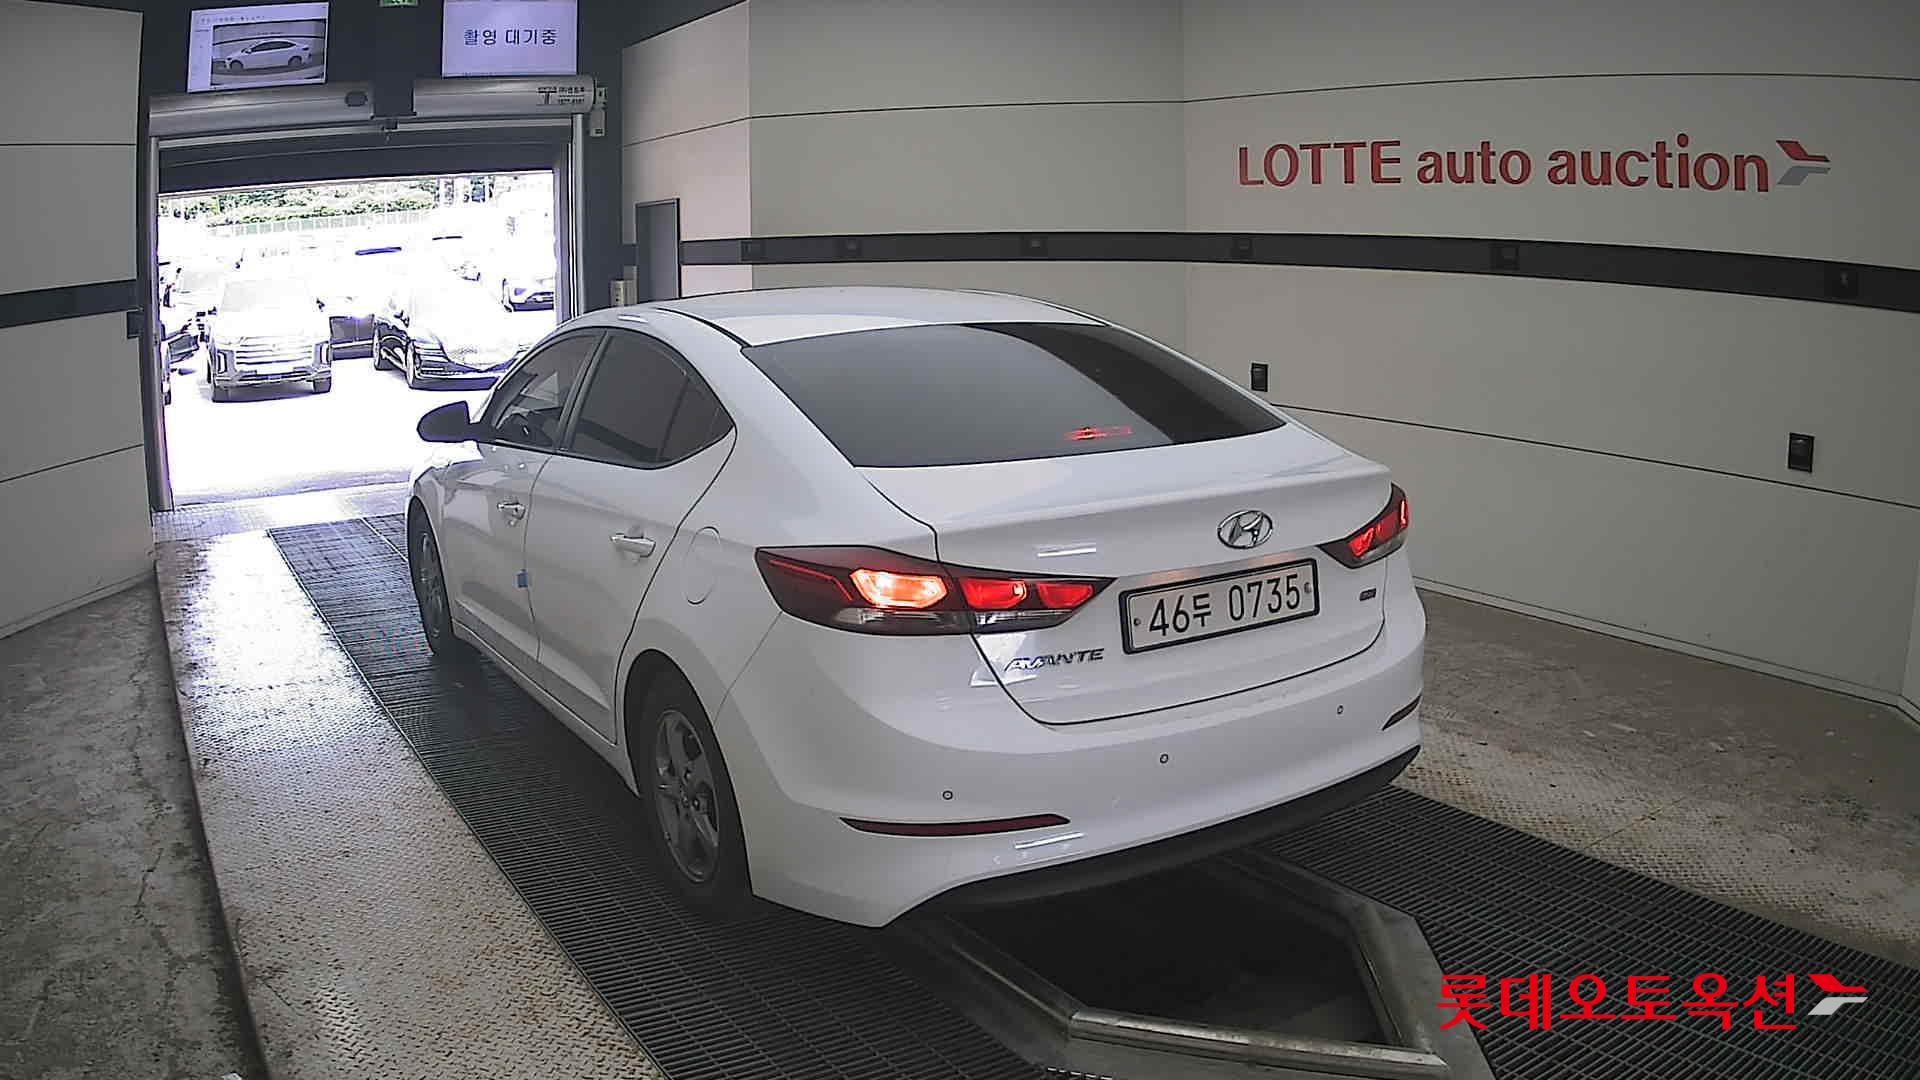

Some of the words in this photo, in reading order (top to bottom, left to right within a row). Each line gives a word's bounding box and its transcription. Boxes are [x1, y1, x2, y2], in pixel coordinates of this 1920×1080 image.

[464, 29, 497, 46] 촬영
[505, 29, 557, 45] 대기중
[1239, 140, 1401, 187] LOTTE
[1417, 141, 1531, 185] auto
[1548, 133, 1768, 192] auction
[1149, 593, 1211, 636] 46두
[1229, 574, 1300, 621] 0735
[1004, 648, 1104, 672] AVANTE
